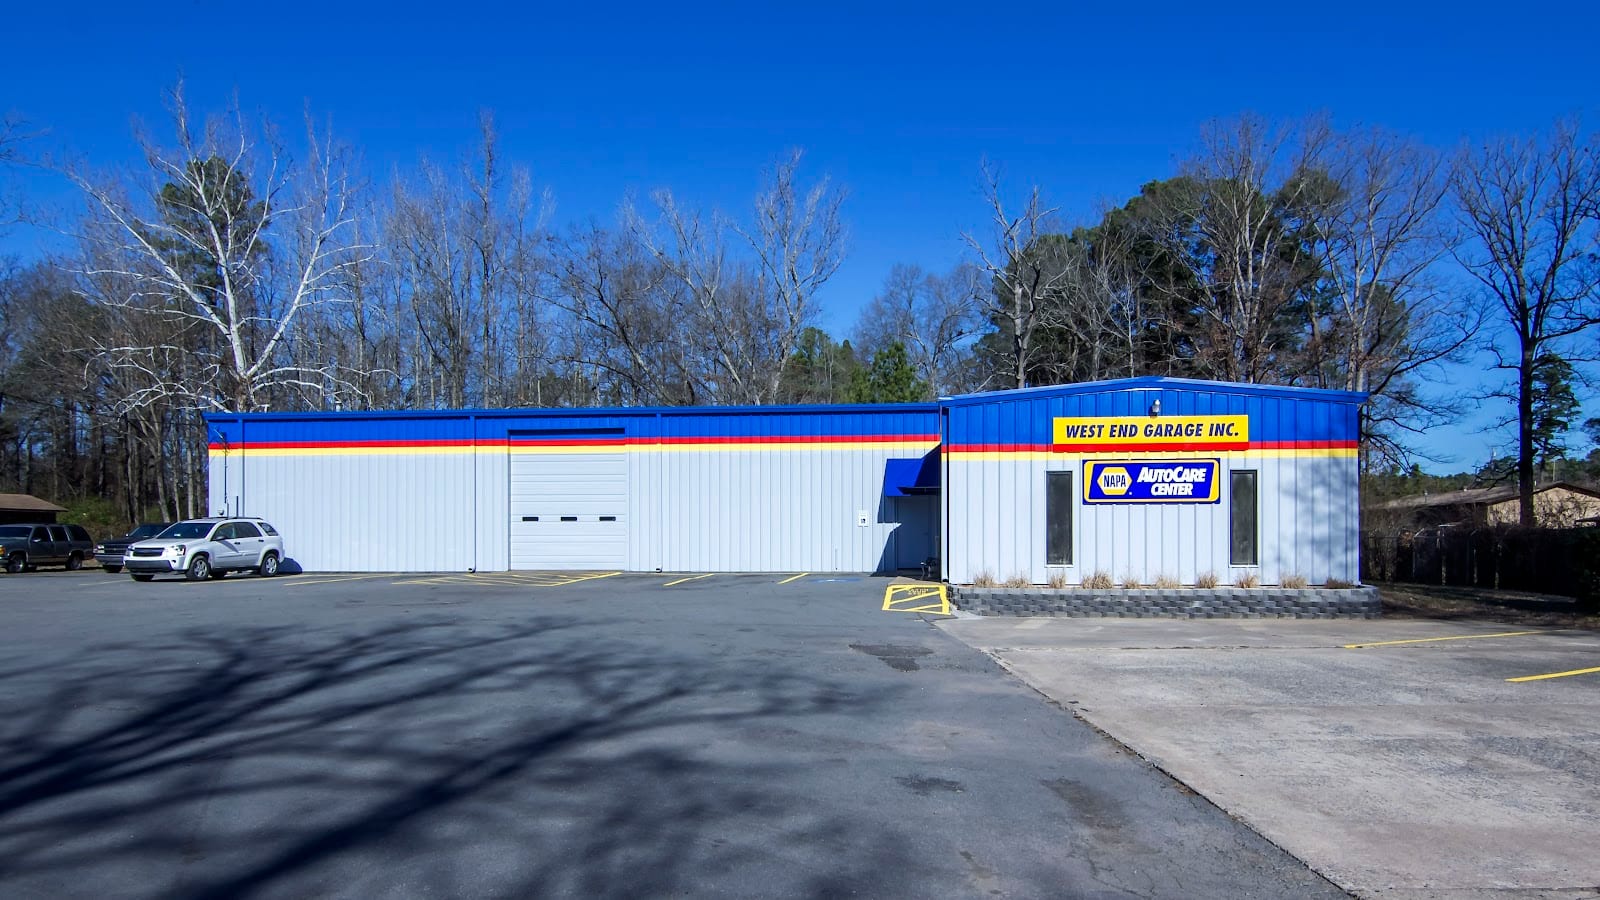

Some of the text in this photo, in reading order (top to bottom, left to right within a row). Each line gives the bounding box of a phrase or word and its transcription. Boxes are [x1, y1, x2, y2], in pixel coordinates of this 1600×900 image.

[1066, 422, 1239, 438] WEST END GARAGE INC.
[1103, 474, 1127, 488] NAPA
[1150, 483, 1193, 496] CENTER
